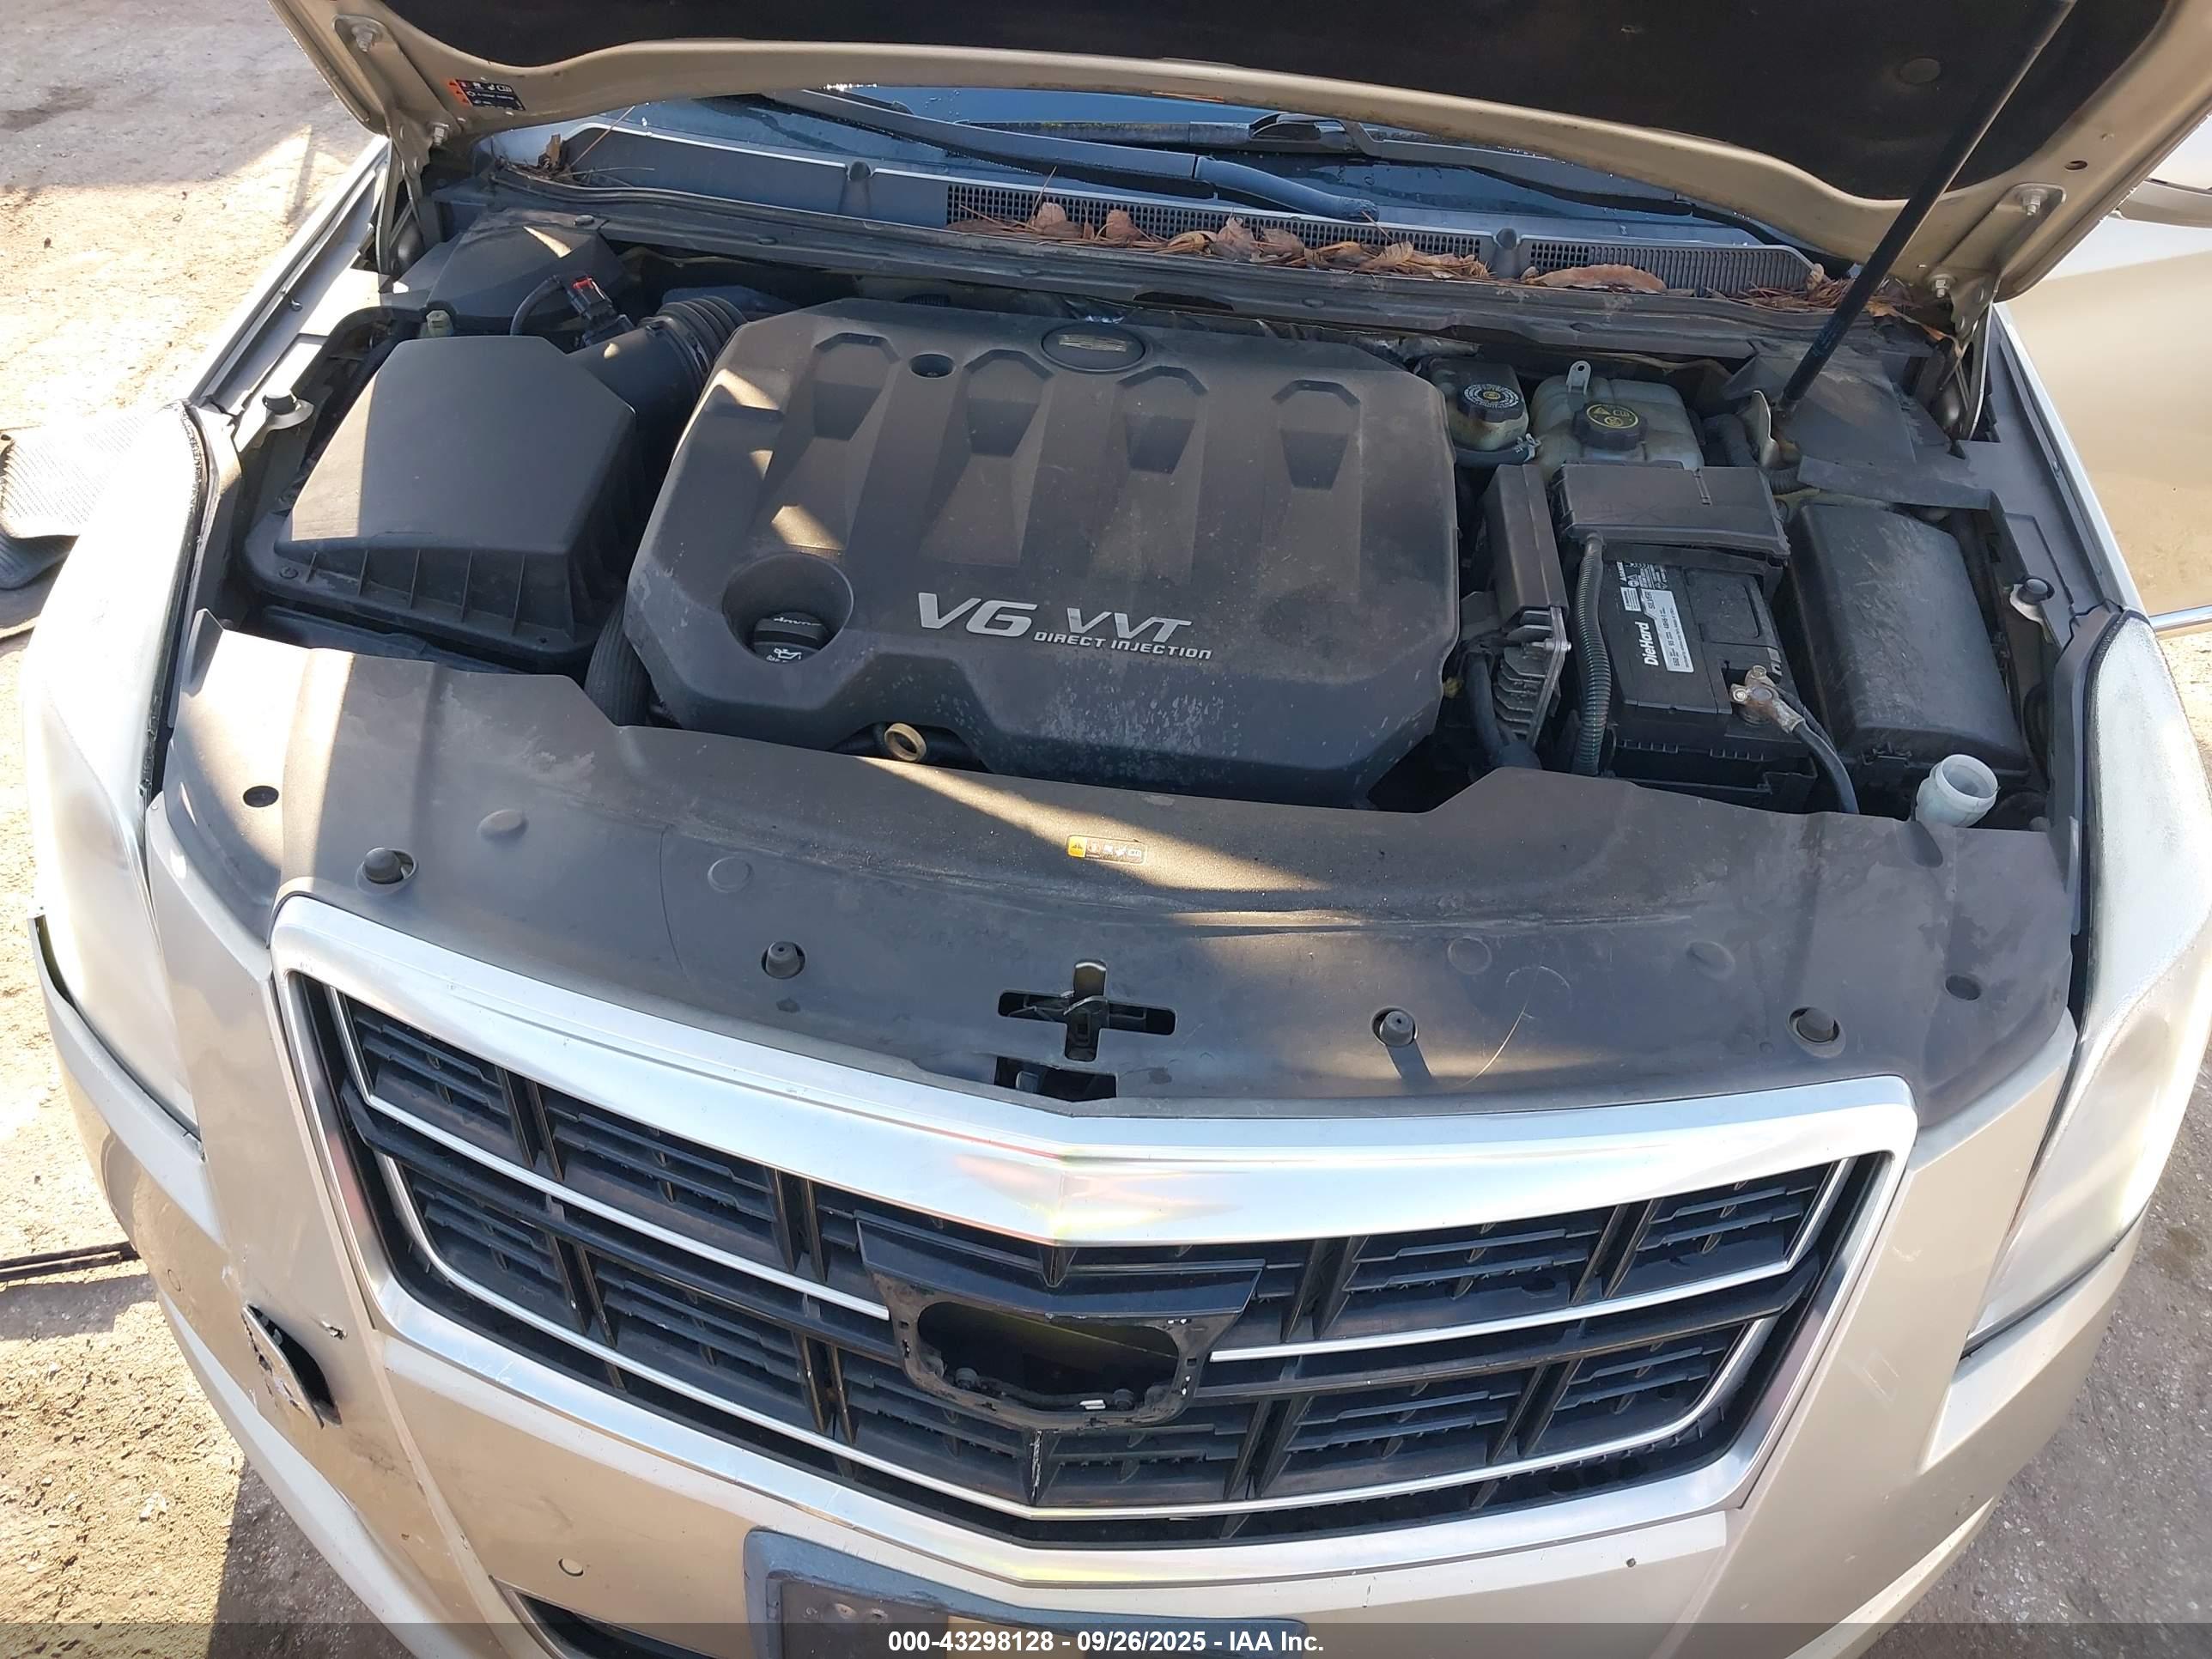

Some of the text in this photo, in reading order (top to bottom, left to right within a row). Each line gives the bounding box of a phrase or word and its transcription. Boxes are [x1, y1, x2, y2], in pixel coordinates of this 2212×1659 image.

[918, 592, 1193, 642] V6 VVT
[1034, 630, 1212, 660] DIRECT INJECTION
[1634, 621, 1659, 666] DieHard
